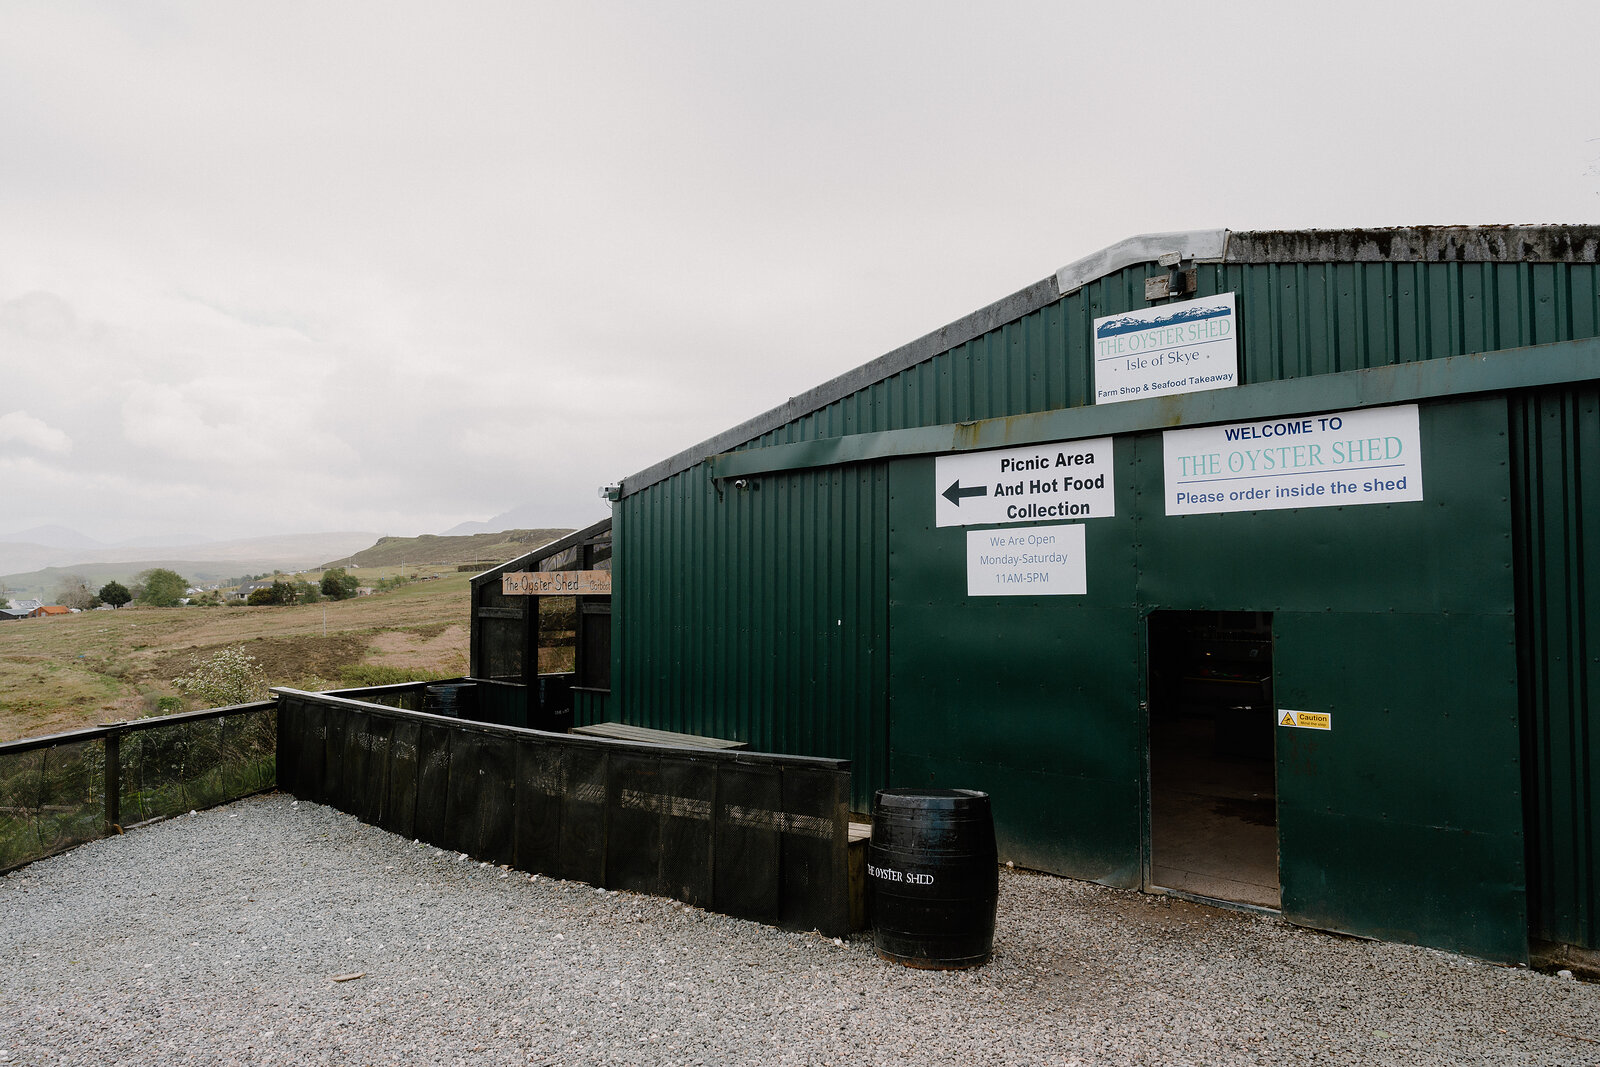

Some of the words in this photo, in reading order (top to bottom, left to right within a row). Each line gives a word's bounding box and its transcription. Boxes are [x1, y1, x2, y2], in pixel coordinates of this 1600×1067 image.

[1098, 337, 1125, 356] THE
[1129, 327, 1184, 351] OYSTER
[1189, 319, 1230, 340] SHED
[1127, 358, 1147, 371] Isle
[1151, 354, 1164, 366] of
[1168, 351, 1200, 365] Skye
[1120, 386, 1140, 395] Shop
[1152, 378, 1186, 390] Seafood
[1189, 373, 1233, 385] Takeaway
[1225, 420, 1312, 442] WELCOME
[1318, 417, 1342, 431] TO
[1001, 456, 1049, 472] Picnic
[1055, 452, 1094, 467] Area
[1178, 453, 1222, 477] THE
[1228, 444, 1325, 473] OYSTER
[1332, 436, 1403, 464] SHED
[994, 481, 1023, 497] And
[1029, 479, 1058, 494] Hot
[1064, 474, 1104, 491] Food
[1177, 491, 1224, 504] Please
[1229, 488, 1271, 501] order
[1276, 482, 1325, 498] inside
[1331, 479, 1357, 493] the
[1363, 476, 1407, 492] shed
[1007, 501, 1090, 519] Collection
[990, 537, 1005, 546] We
[1008, 536, 1024, 545] Are
[1028, 534, 1055, 547] Open
[980, 552, 1068, 566] Monday-Saturday
[505, 576, 518, 591] The
[521, 576, 552, 594] Oyster
[555, 574, 579, 591] Shed
[996, 572, 1049, 583] 11AM-5PM
[876, 868, 902, 882] OYSTER
[906, 873, 934, 885] SHED
